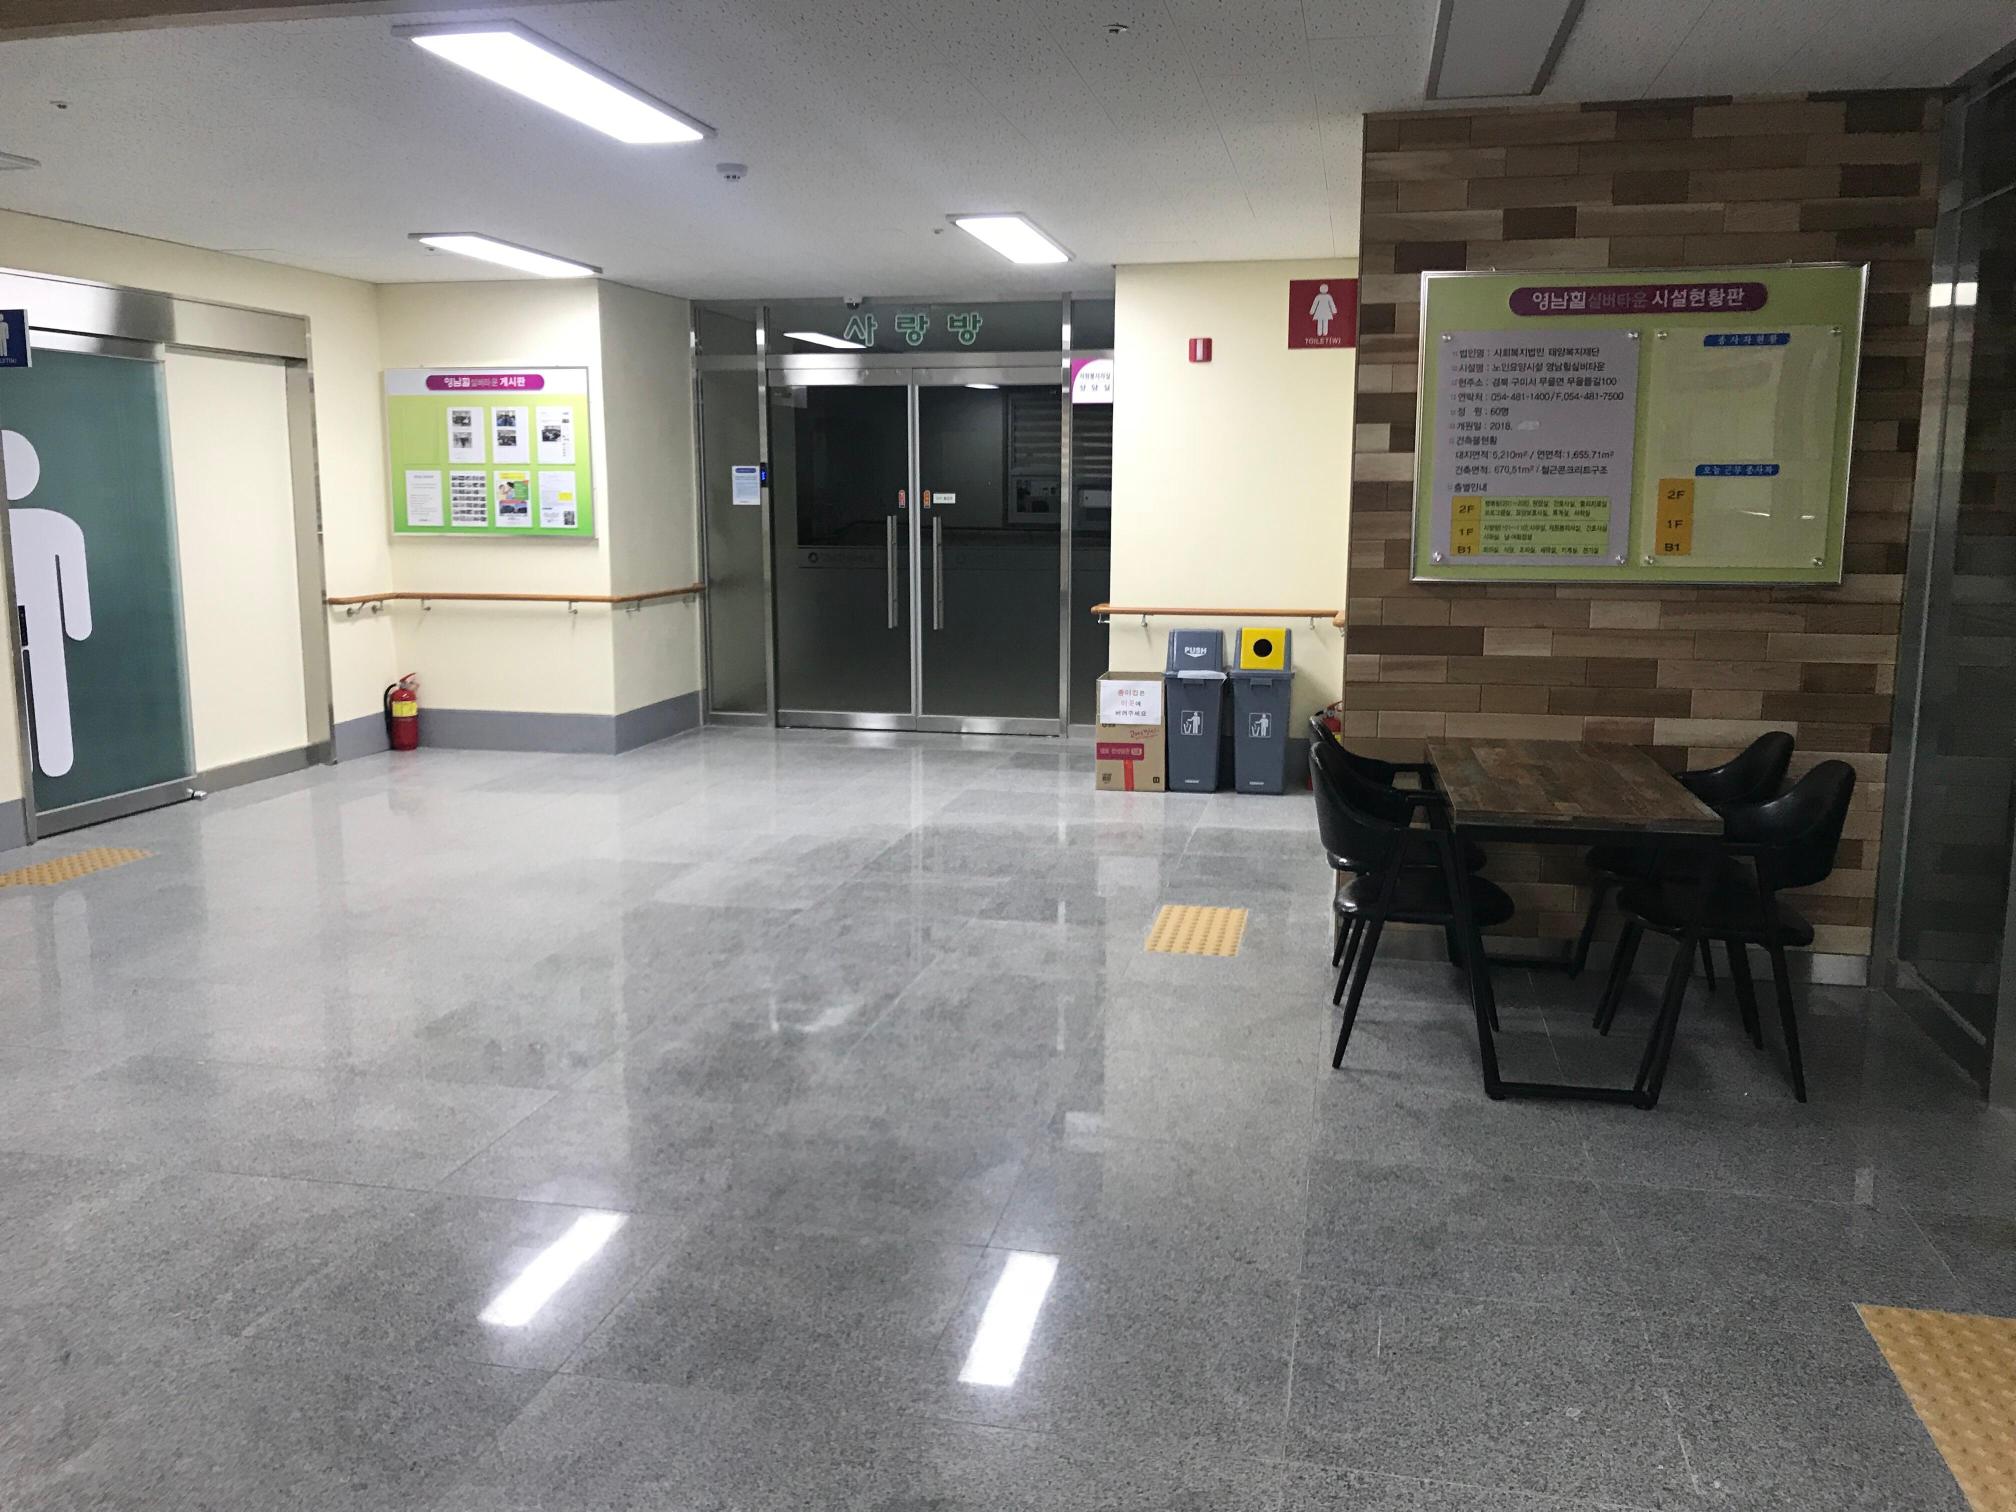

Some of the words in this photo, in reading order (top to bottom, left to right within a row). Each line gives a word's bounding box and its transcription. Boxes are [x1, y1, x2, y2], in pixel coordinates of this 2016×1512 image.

[1651, 288, 1745, 308] 시설현황판
[499, 376, 526, 387] 게시판
[1511, 377, 1537, 387] 구미시
[1490, 407, 1509, 417] 60명
[1541, 465, 1609, 475] 철근콘크리트구조
[1667, 490, 1685, 500] 2F
[1458, 504, 1474, 514] 2F
[1667, 519, 1683, 529] 1F
[1458, 528, 1474, 537] 1F
[1457, 545, 1472, 555] B1
[1664, 542, 1681, 553] B1
[1184, 646, 1207, 656] PUSH
